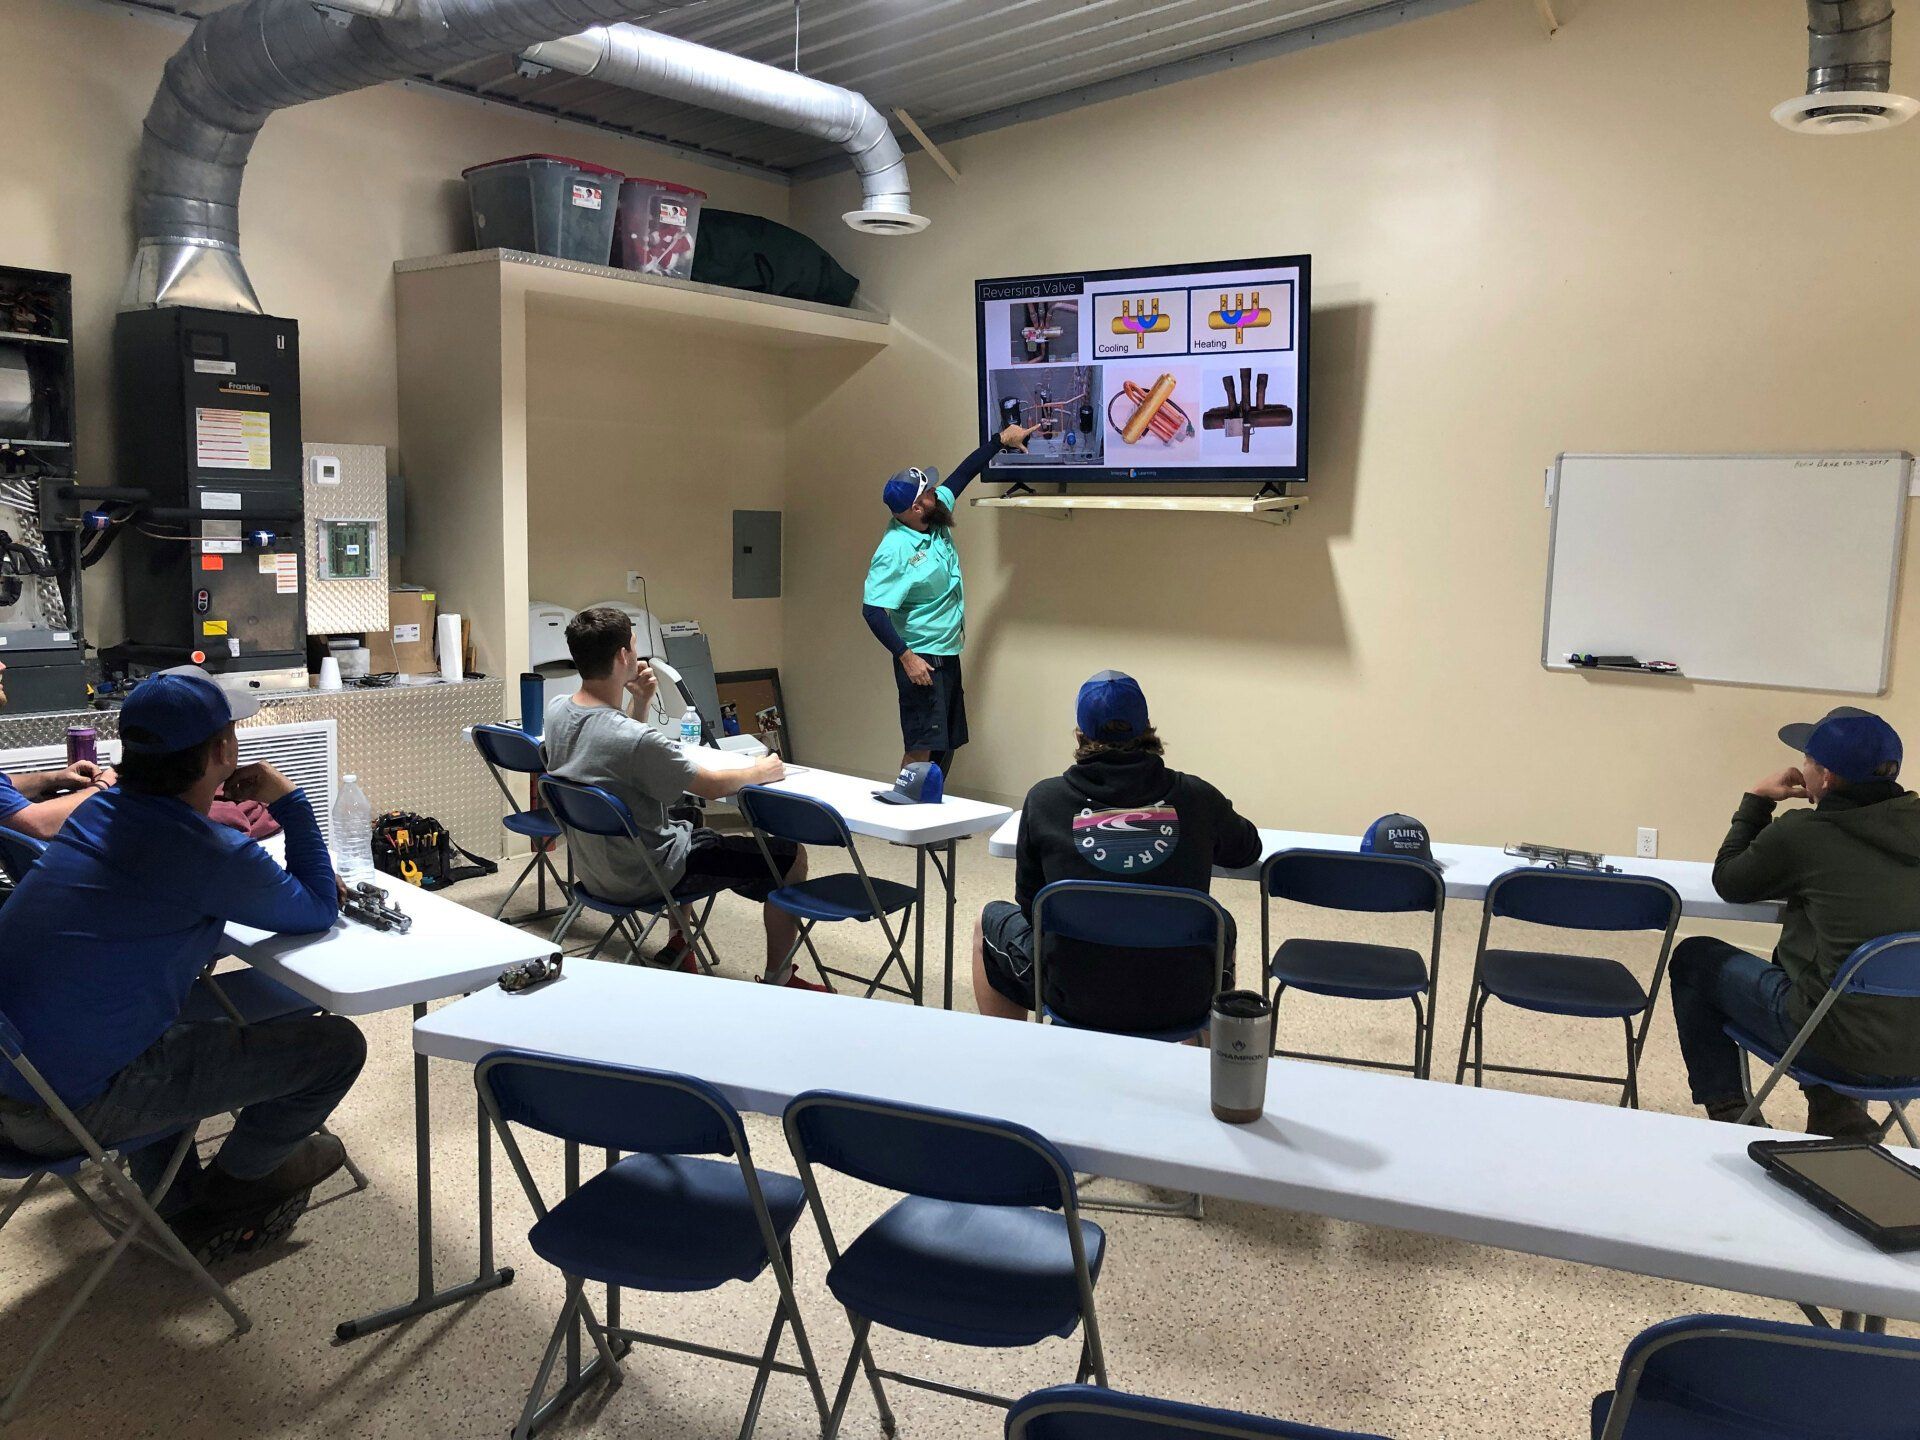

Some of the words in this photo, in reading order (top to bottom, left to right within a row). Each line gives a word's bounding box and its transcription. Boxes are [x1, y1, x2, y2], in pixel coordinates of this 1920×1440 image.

[983, 284, 1040, 298] Reversing
[1043, 282, 1076, 294] Valve
[1098, 344, 1129, 353] Cooling
[1194, 339, 1227, 349] Heating
[228, 382, 261, 391] Franklin
[1388, 829, 1424, 841] BAHR'S
[1123, 824, 1173, 869] SURF
[1216, 1050, 1264, 1061] CHAMPION
